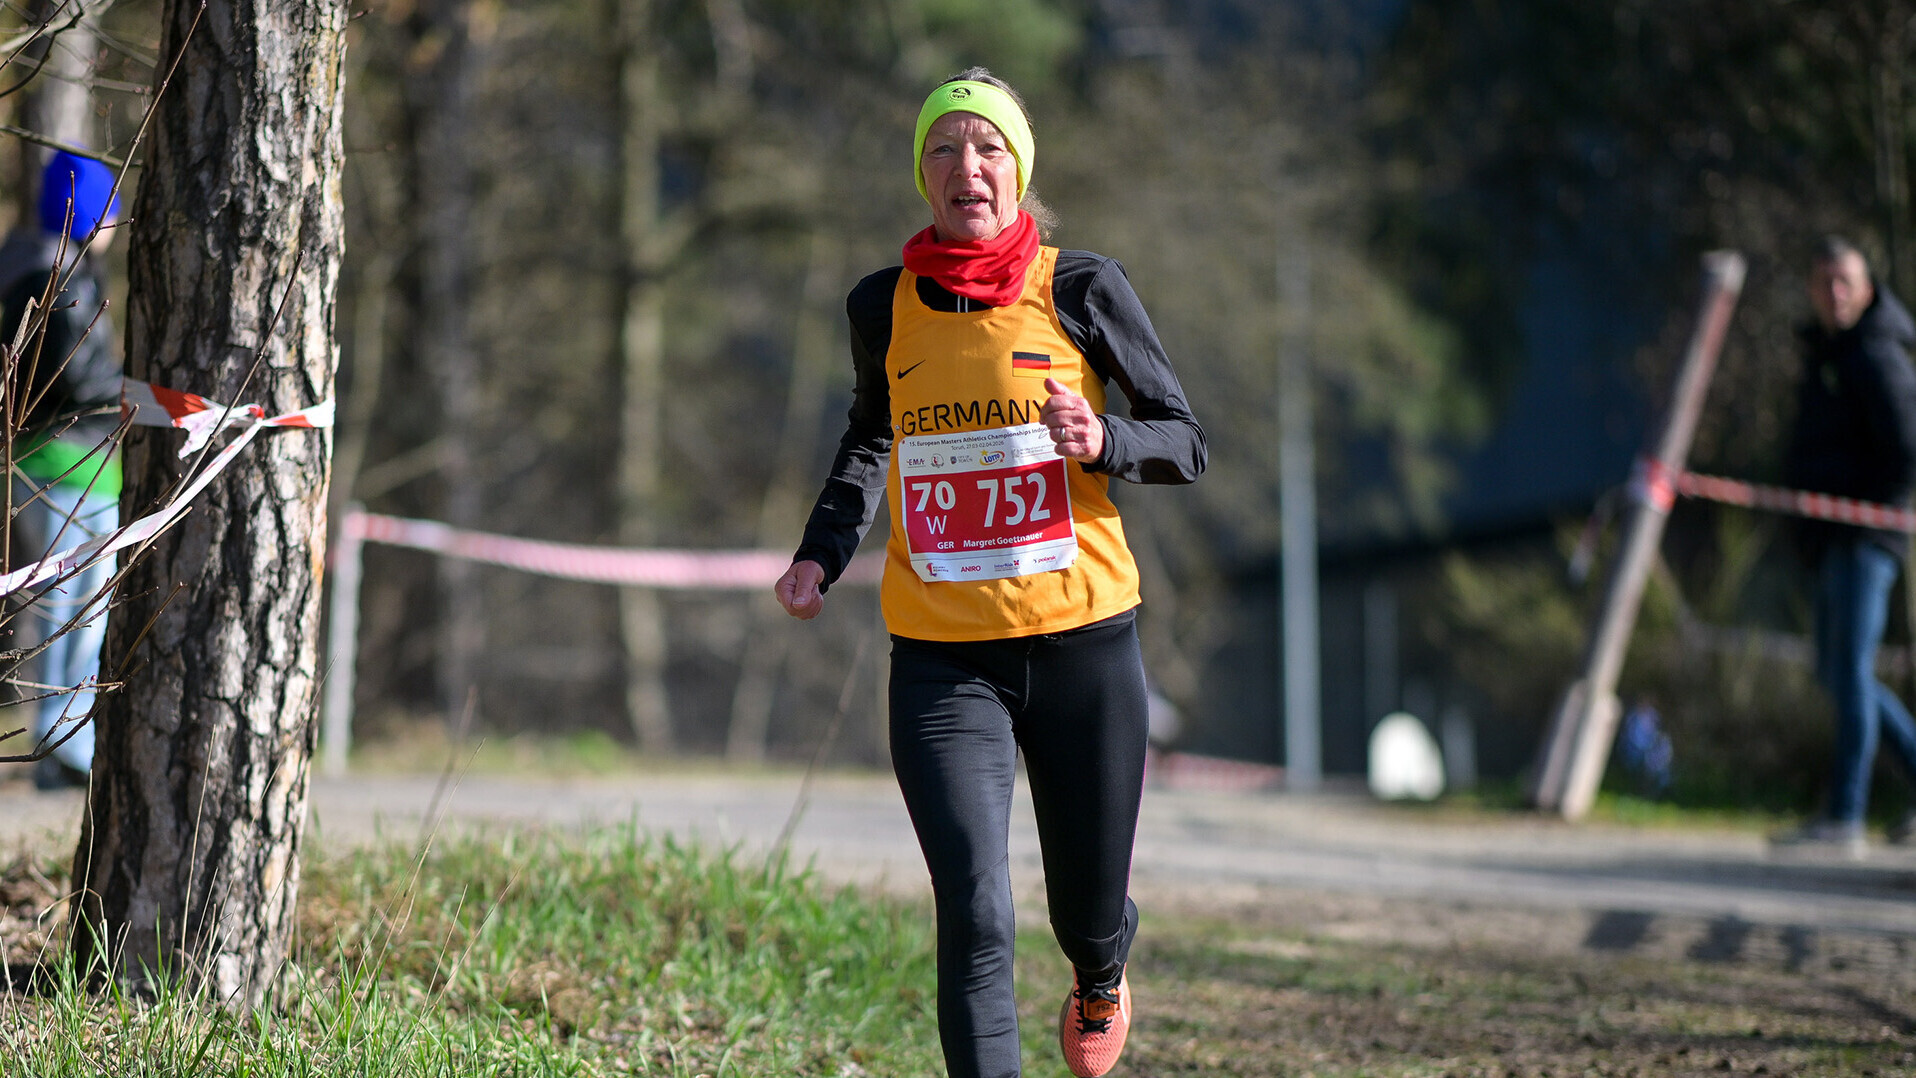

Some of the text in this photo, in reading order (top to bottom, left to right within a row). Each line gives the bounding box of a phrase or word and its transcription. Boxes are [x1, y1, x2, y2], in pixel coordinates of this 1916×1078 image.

[917, 440, 940, 448] European
[940, 438, 962, 446] Masters
[963, 435, 987, 443] Athletics
[987, 429, 1031, 441] Championships
[1031, 426, 1047, 434] Indoo
[983, 453, 1000, 463] LOTTO
[911, 480, 956, 512] 70
[976, 472, 1051, 528] 752
[926, 515, 947, 535] W
[937, 531, 1043, 550] GER Margret Goettnauer
[960, 565, 981, 573] ANIRO
